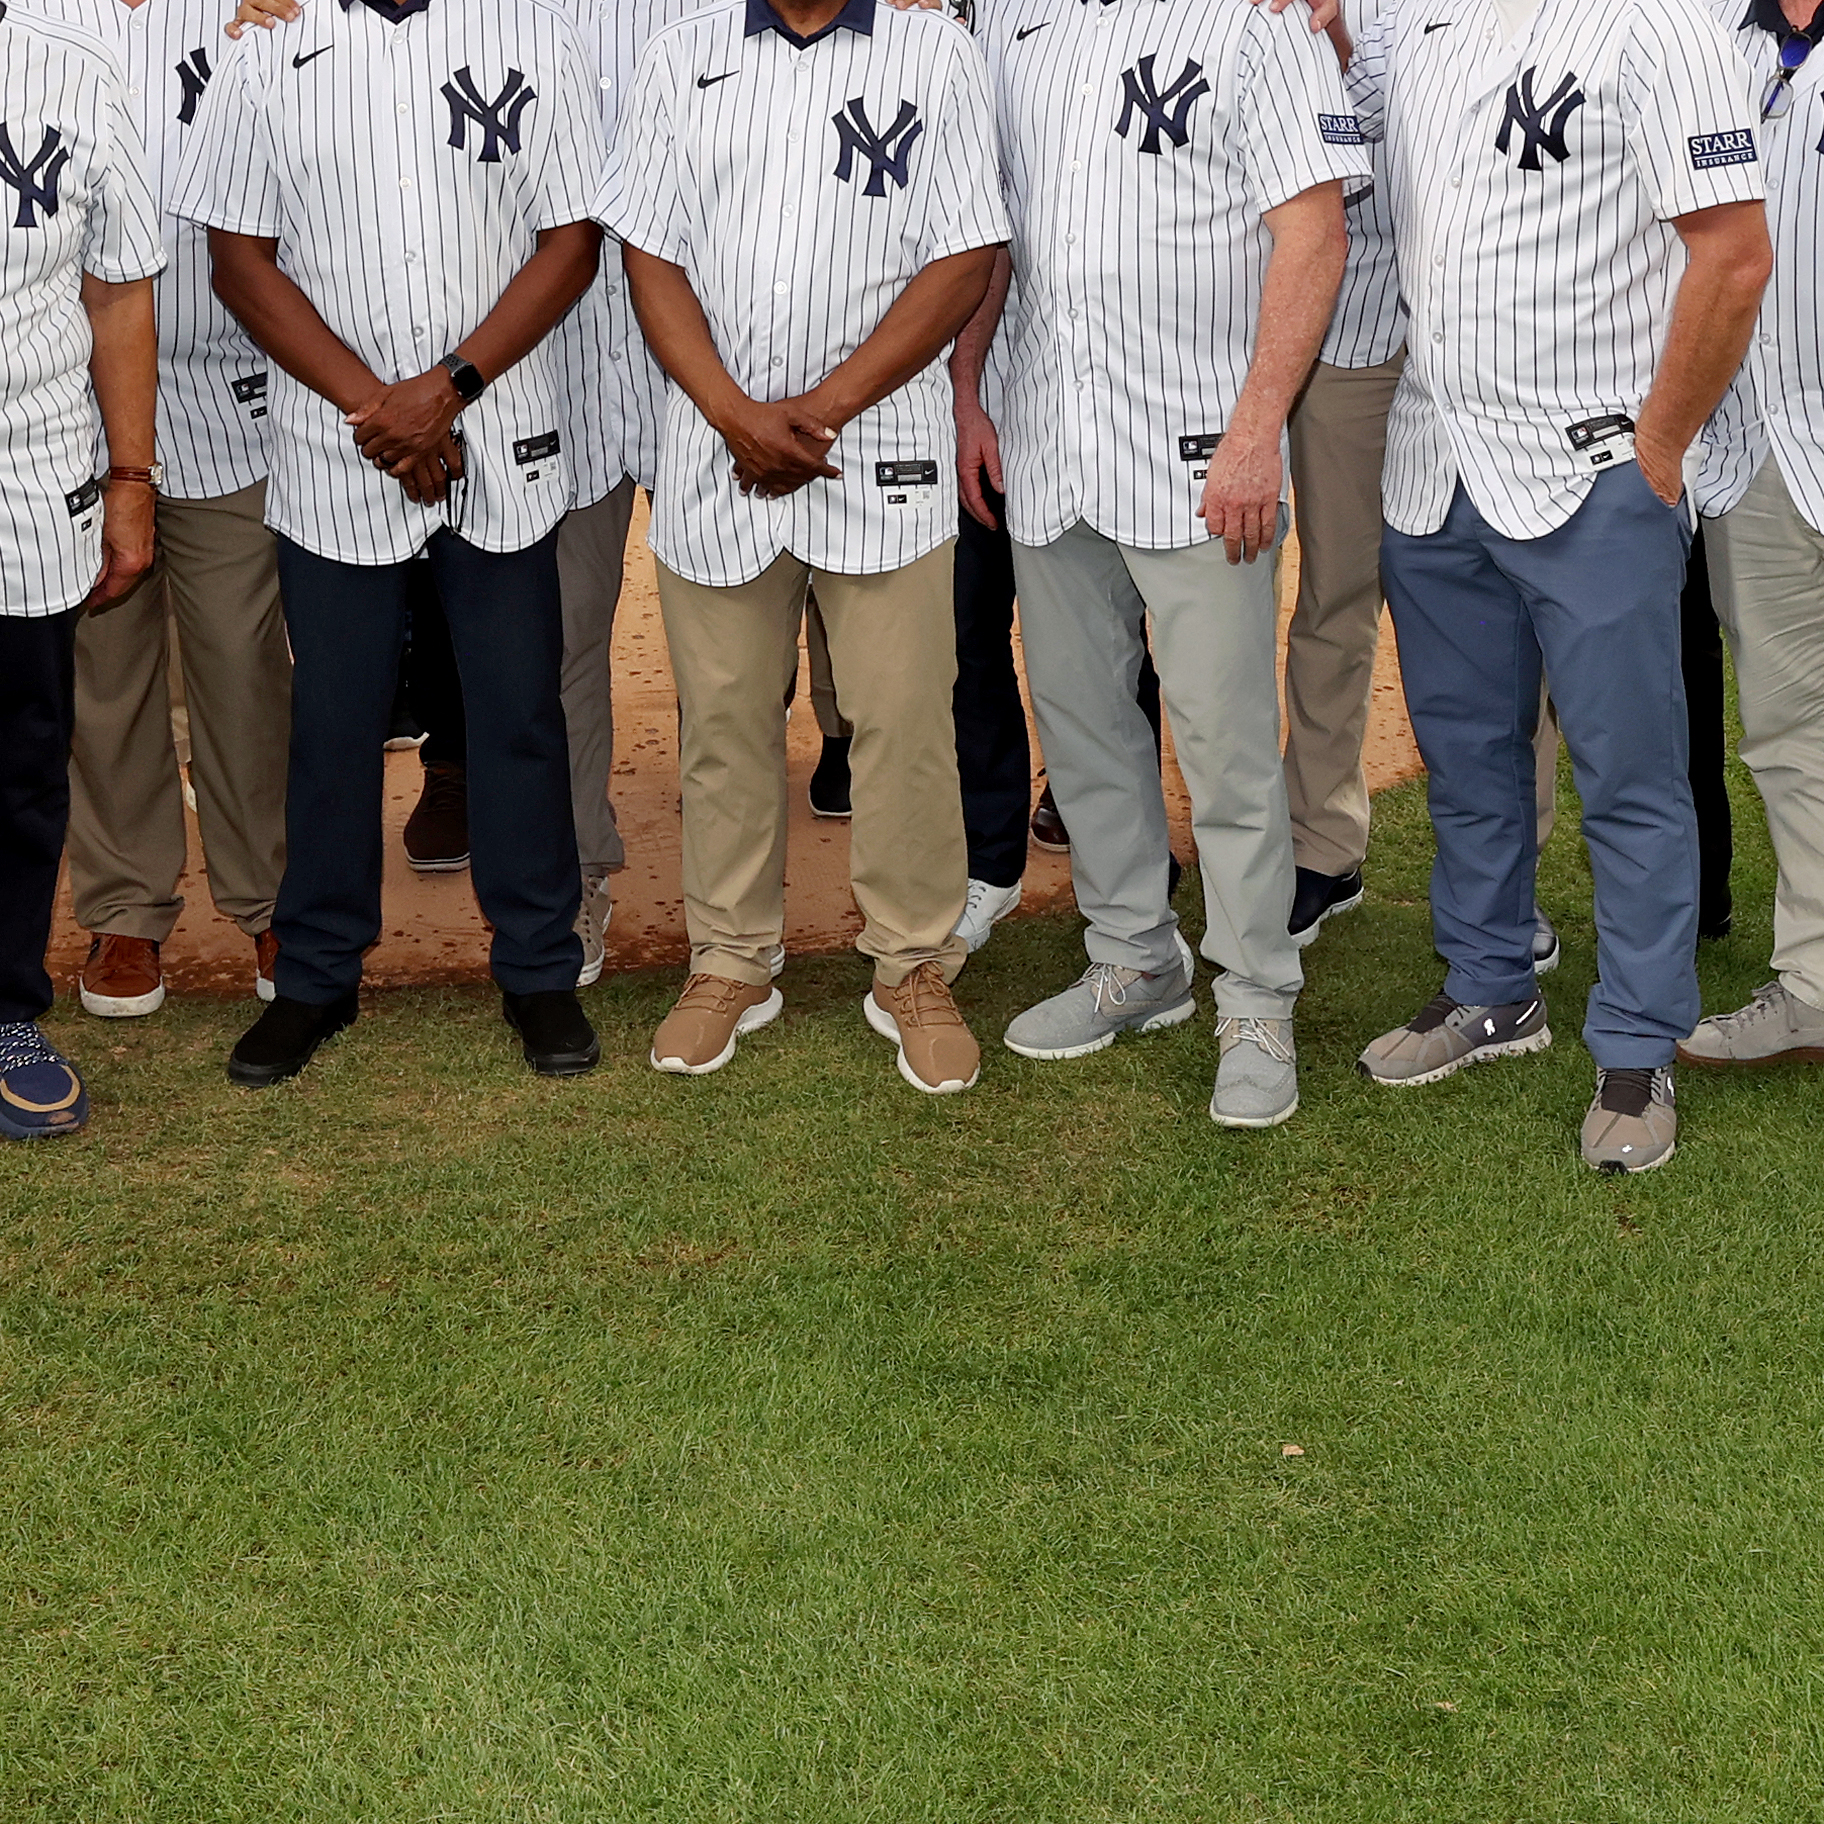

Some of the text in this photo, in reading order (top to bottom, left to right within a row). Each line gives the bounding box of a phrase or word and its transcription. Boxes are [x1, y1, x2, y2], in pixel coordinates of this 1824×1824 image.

[439, 64, 537, 164] NY
[1114, 53, 1211, 156] NY
[1321, 114, 1358, 132] STARR
[1494, 65, 1587, 171] NY
[832, 96, 924, 197] NY
[1324, 134, 1361, 142] INSURANCE
[1691, 131, 1752, 155] STARR
[1696, 153, 1753, 167] INSURANCE
